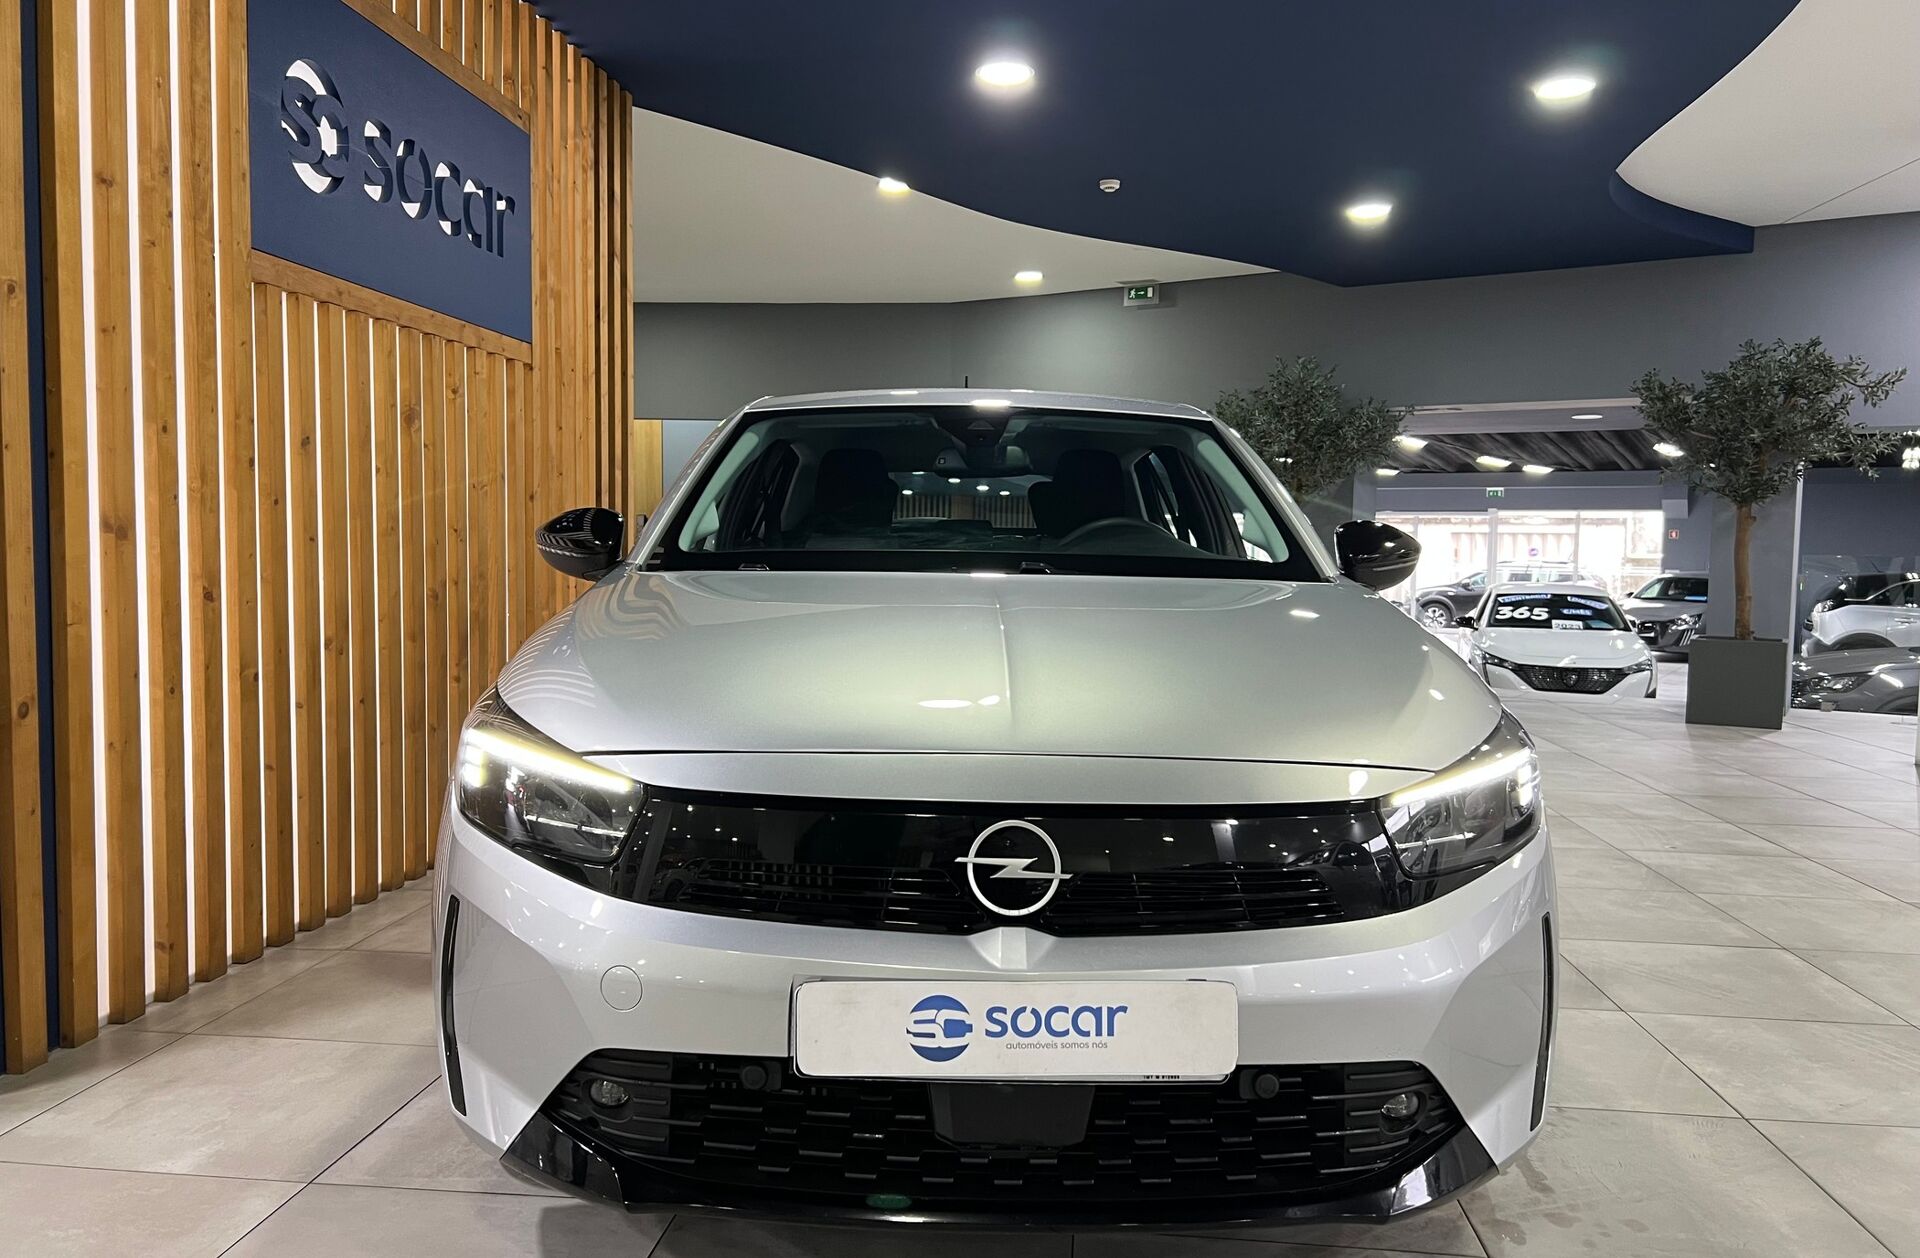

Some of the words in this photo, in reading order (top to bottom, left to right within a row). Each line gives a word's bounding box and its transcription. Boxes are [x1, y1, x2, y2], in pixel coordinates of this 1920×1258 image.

[363, 118, 516, 258] socar
[1495, 606, 1549, 621] 365
[984, 1005, 1129, 1038] socar
[1005, 1040, 1059, 1050] automóveis
[1060, 1042, 1090, 1050] somos
[1091, 1039, 1109, 1050] nós
